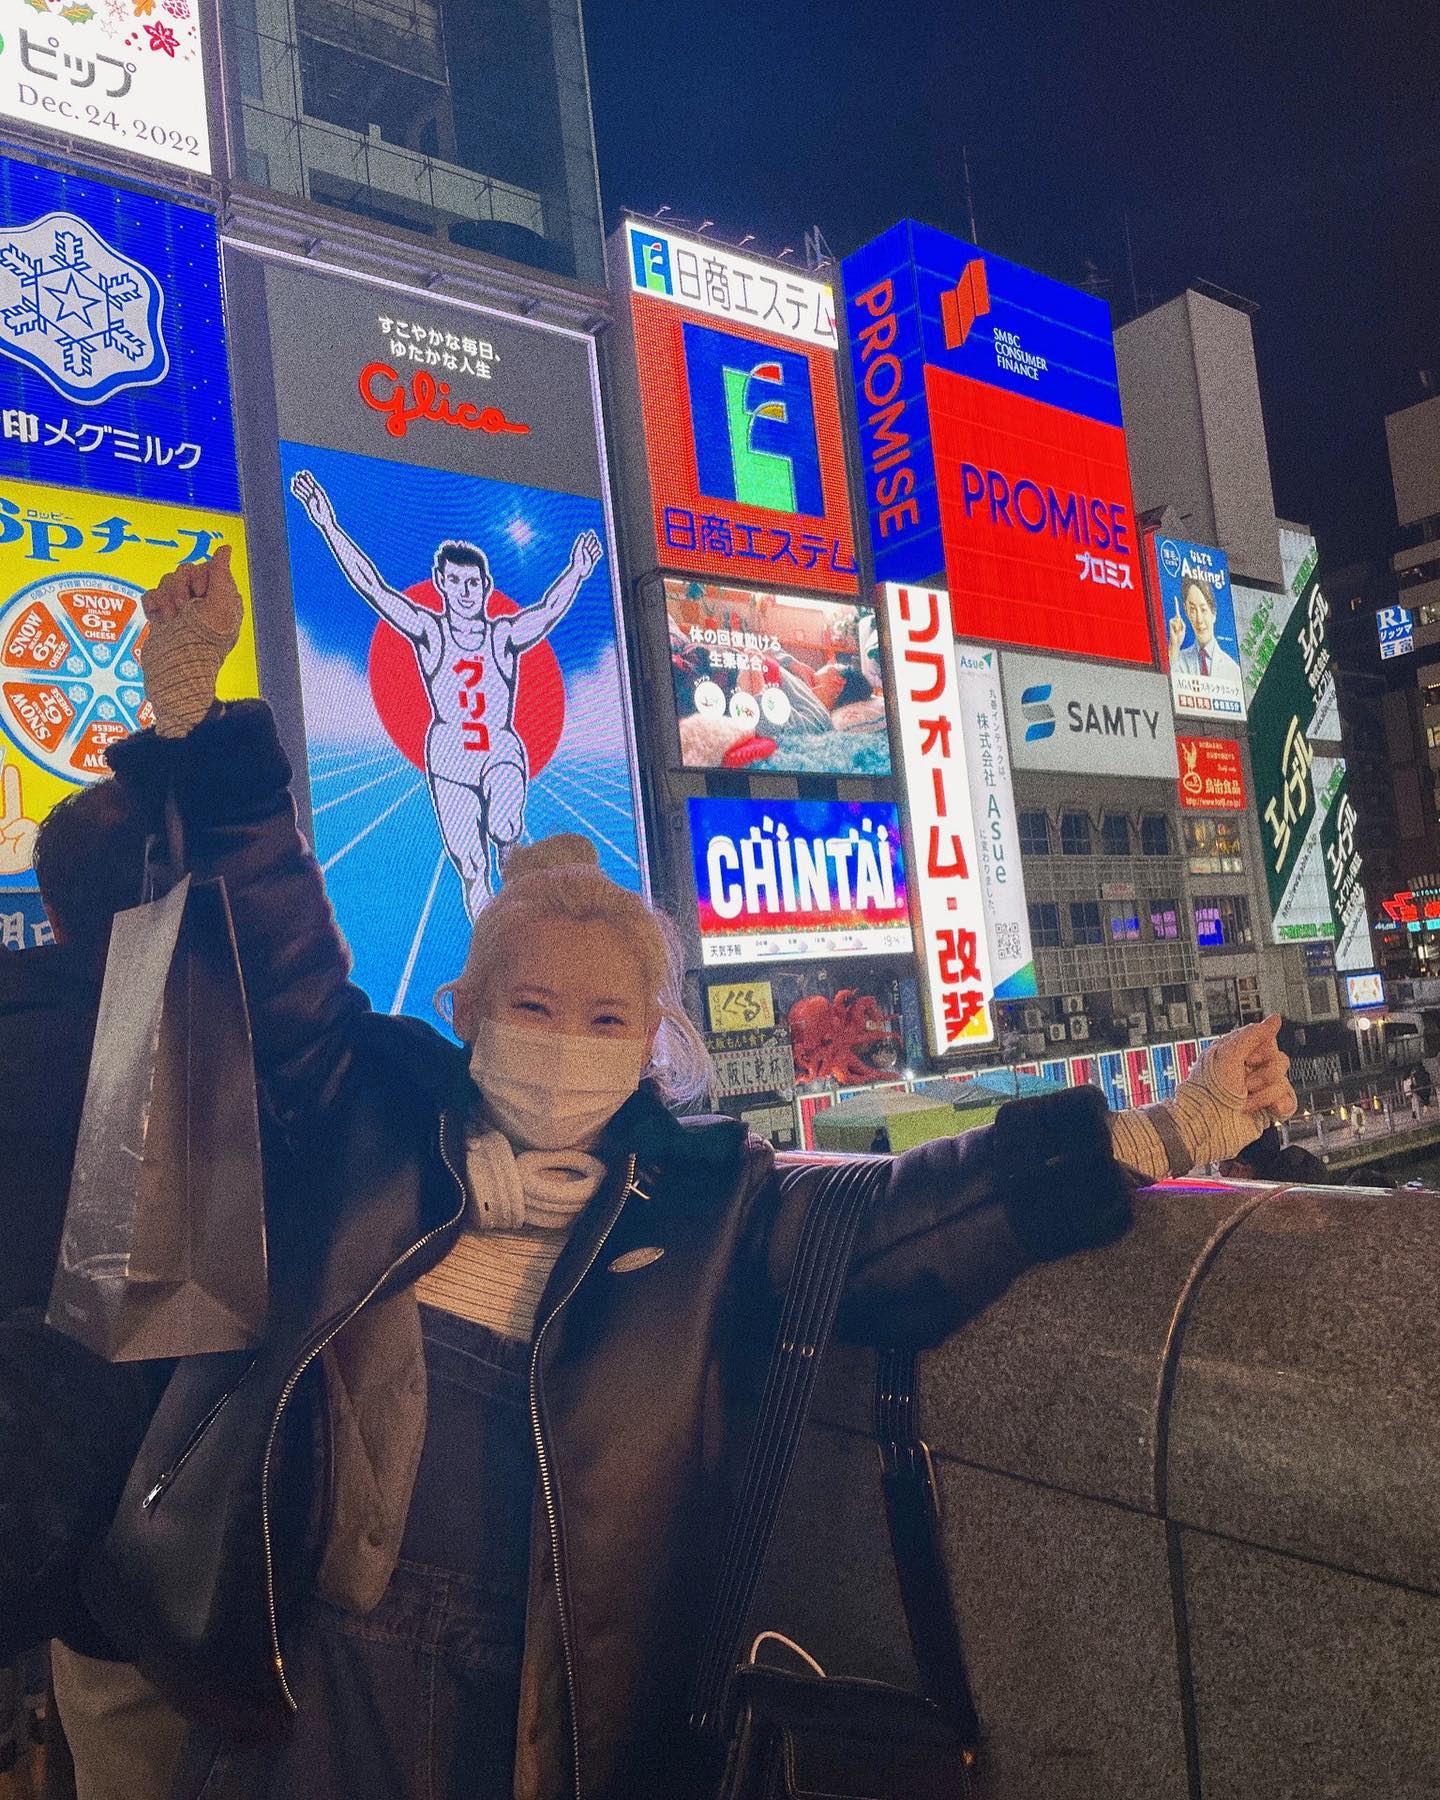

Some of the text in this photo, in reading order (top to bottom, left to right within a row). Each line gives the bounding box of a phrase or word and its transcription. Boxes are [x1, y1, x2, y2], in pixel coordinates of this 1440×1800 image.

[19, 28, 137, 98] ピップ
[18, 83, 201, 156] Dec. 24, 2022
[677, 249, 837, 341] 日商エステム
[378, 315, 501, 361] すこやかな毎日、
[390, 339, 492, 379] ゆたかな人生
[993, 327, 1021, 348] SMBC
[994, 341, 1048, 371] CONSUMER
[996, 354, 1039, 380] FINANCE
[359, 361, 531, 437] Glico
[854, 278, 920, 537] PROMISE
[960, 462, 1130, 553] PROMISE
[664, 505, 858, 575] 日商エステム
[1075, 552, 1135, 590] プロミス
[1181, 557, 1226, 590] Asking!
[72, 594, 124, 612] SNOW
[81, 613, 117, 632] 6P
[9, 611, 42, 657] SNOW
[84, 630, 116, 640] CHEESE
[960, 655, 984, 669] Asue
[9, 693, 52, 740] SNOW
[452, 655, 491, 752] グリコ
[1067, 701, 1159, 739] SAMTY
[91, 724, 123, 733] CHEESE
[1264, 714, 1314, 874] エイブル
[707, 815, 896, 919] CHINTAI
